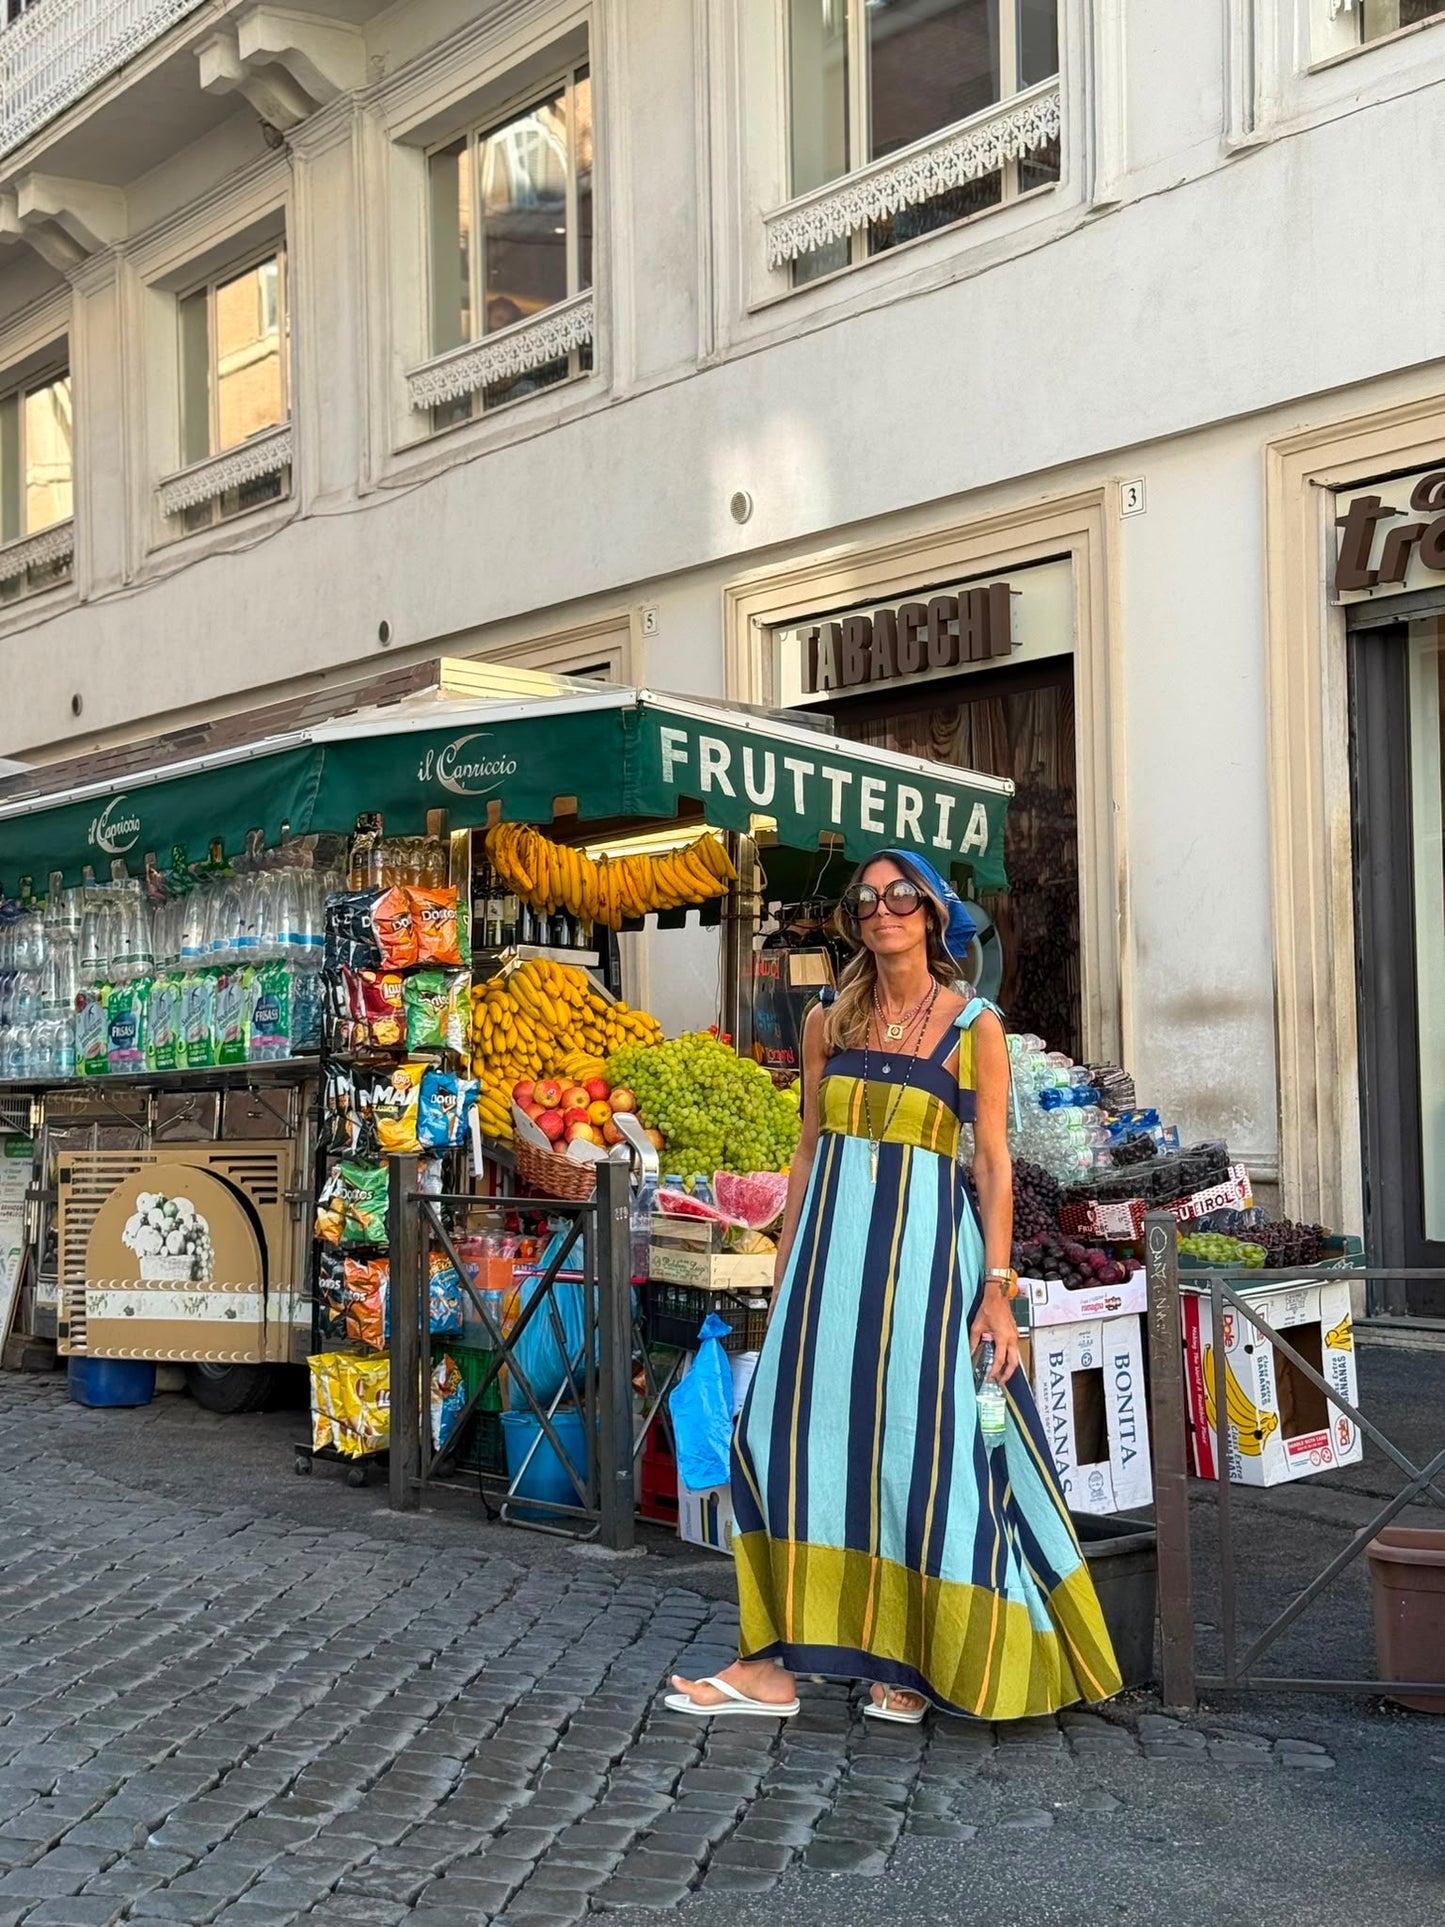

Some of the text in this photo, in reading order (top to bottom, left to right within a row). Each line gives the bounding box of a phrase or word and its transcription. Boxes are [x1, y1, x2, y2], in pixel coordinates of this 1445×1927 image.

[1128, 487, 1137, 507] 3
[647, 613, 654, 629] 5
[796, 582, 1012, 694] TABACCHI
[418, 735, 517, 793] il Capriccio
[659, 726, 989, 857] FRUTTERIA
[97, 800, 140, 852] Capriccio
[1114, 1352, 1138, 1465] BONITA
[1256, 1356, 1267, 1405] BANANAS
[1049, 1351, 1073, 1494] BANANAS
[1231, 1425, 1244, 1480] Class Extra
